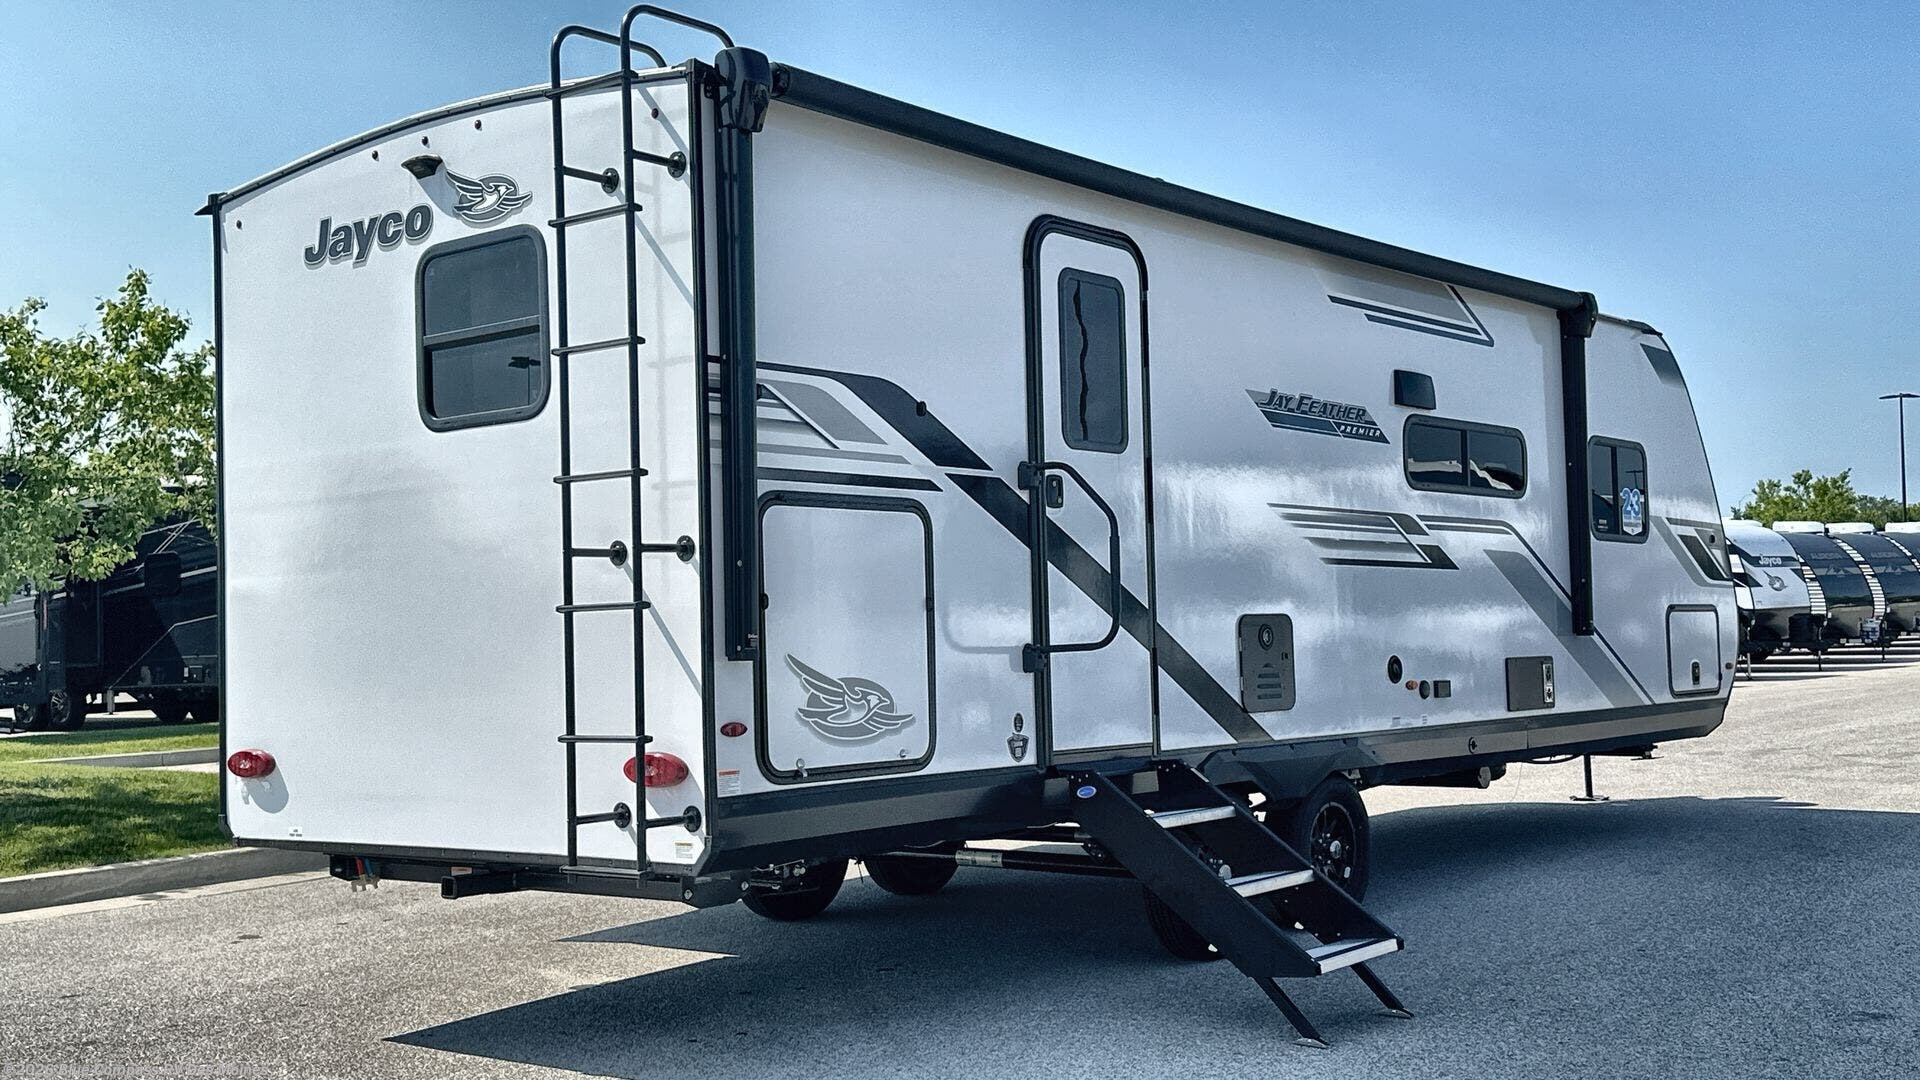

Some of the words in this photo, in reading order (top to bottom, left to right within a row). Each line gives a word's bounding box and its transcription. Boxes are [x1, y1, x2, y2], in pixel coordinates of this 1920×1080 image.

[304, 203, 433, 267] Jayco
[1295, 393, 1367, 422] FEATHER
[1339, 425, 1381, 437] PREMIER
[1620, 488, 1641, 517] 23
[1759, 553, 1782, 567] Jayco
